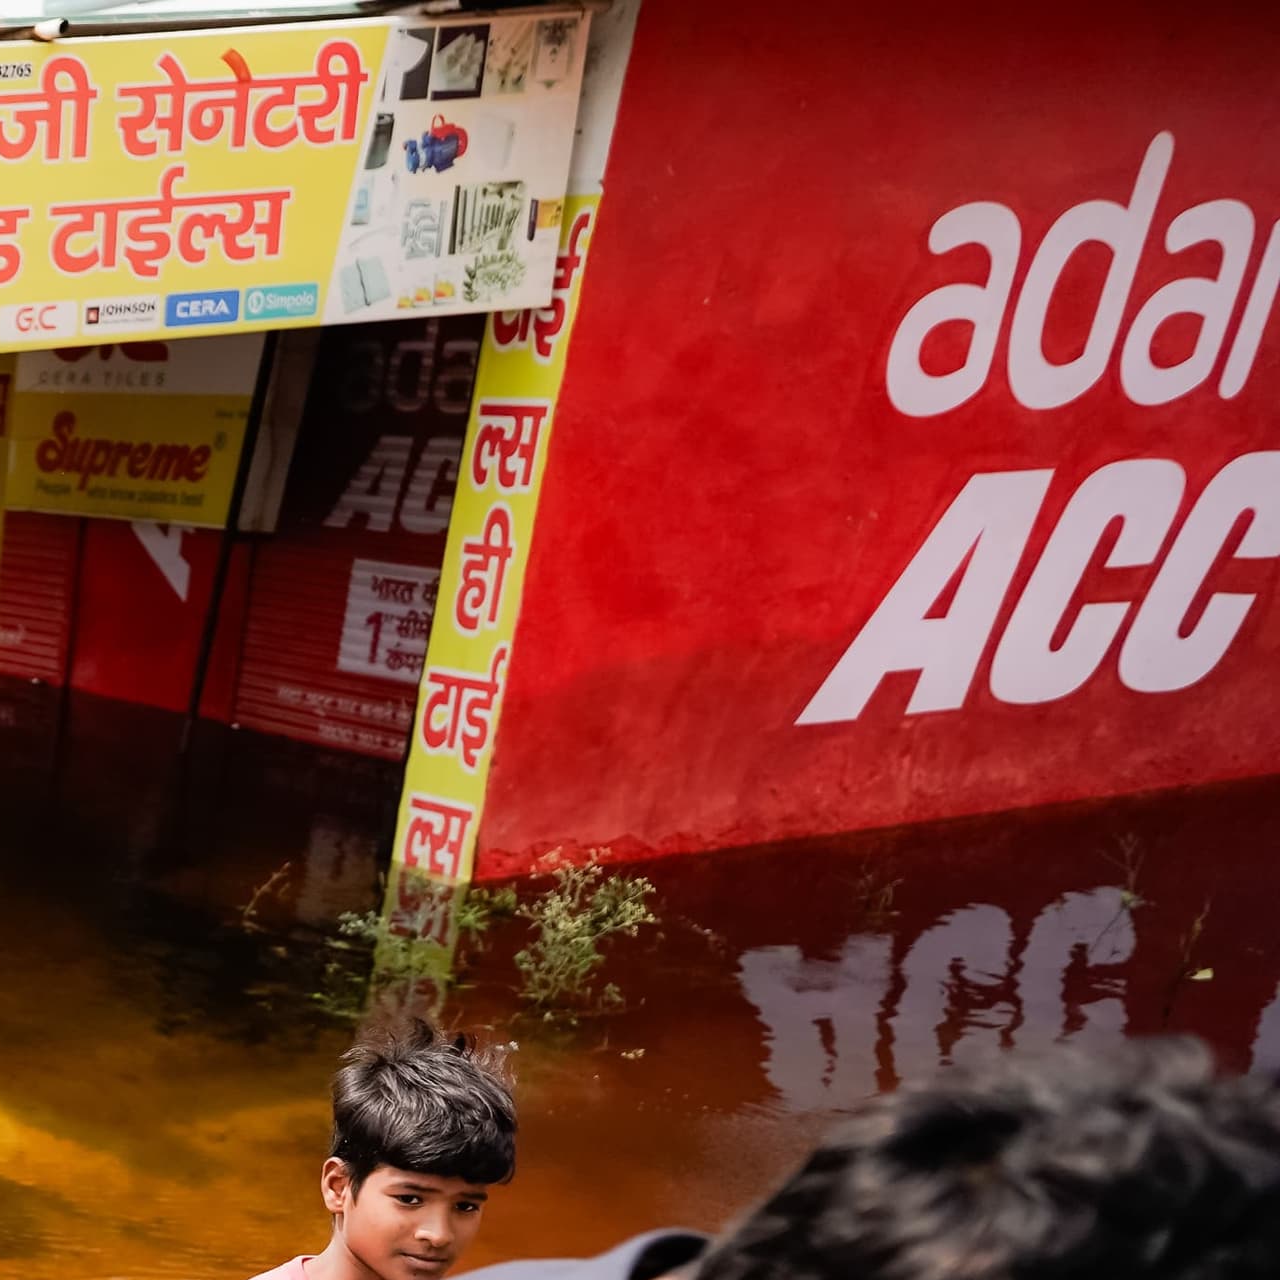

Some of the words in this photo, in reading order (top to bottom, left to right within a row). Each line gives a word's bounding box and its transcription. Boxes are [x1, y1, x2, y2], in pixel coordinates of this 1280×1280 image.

[117, 40, 369, 157] सेनेटरी
[49, 165, 292, 278] टाईल्स
[100, 301, 156, 317] JOHNSON
[175, 298, 231, 319] CERA
[266, 291, 315, 312] Simpolo
[35, 410, 212, 492] Supreme
[455, 508, 513, 629] ही
[794, 449, 1280, 726] ACC
